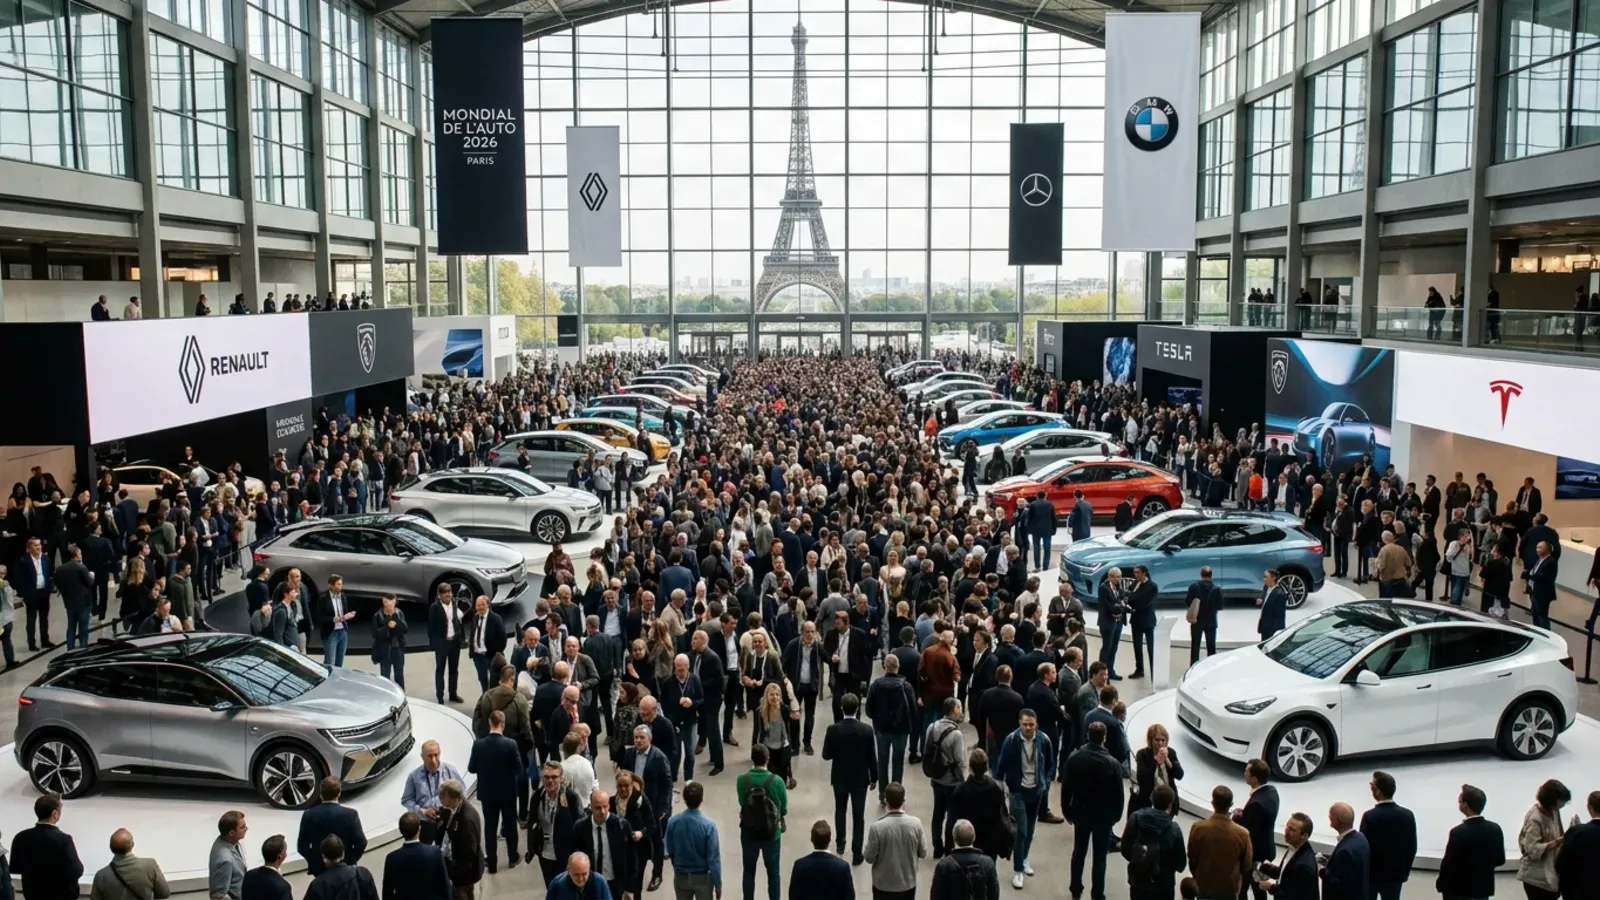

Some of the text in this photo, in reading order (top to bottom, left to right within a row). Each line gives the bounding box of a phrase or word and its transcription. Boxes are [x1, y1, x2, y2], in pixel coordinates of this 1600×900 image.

[443, 108, 516, 121] MONDIAL
[443, 122, 516, 135] DE L'AUTO
[463, 136, 498, 149] 2026
[466, 156, 494, 165] PARIS
[1155, 341, 1192, 362] TESLA
[210, 350, 269, 377] RENAULT
